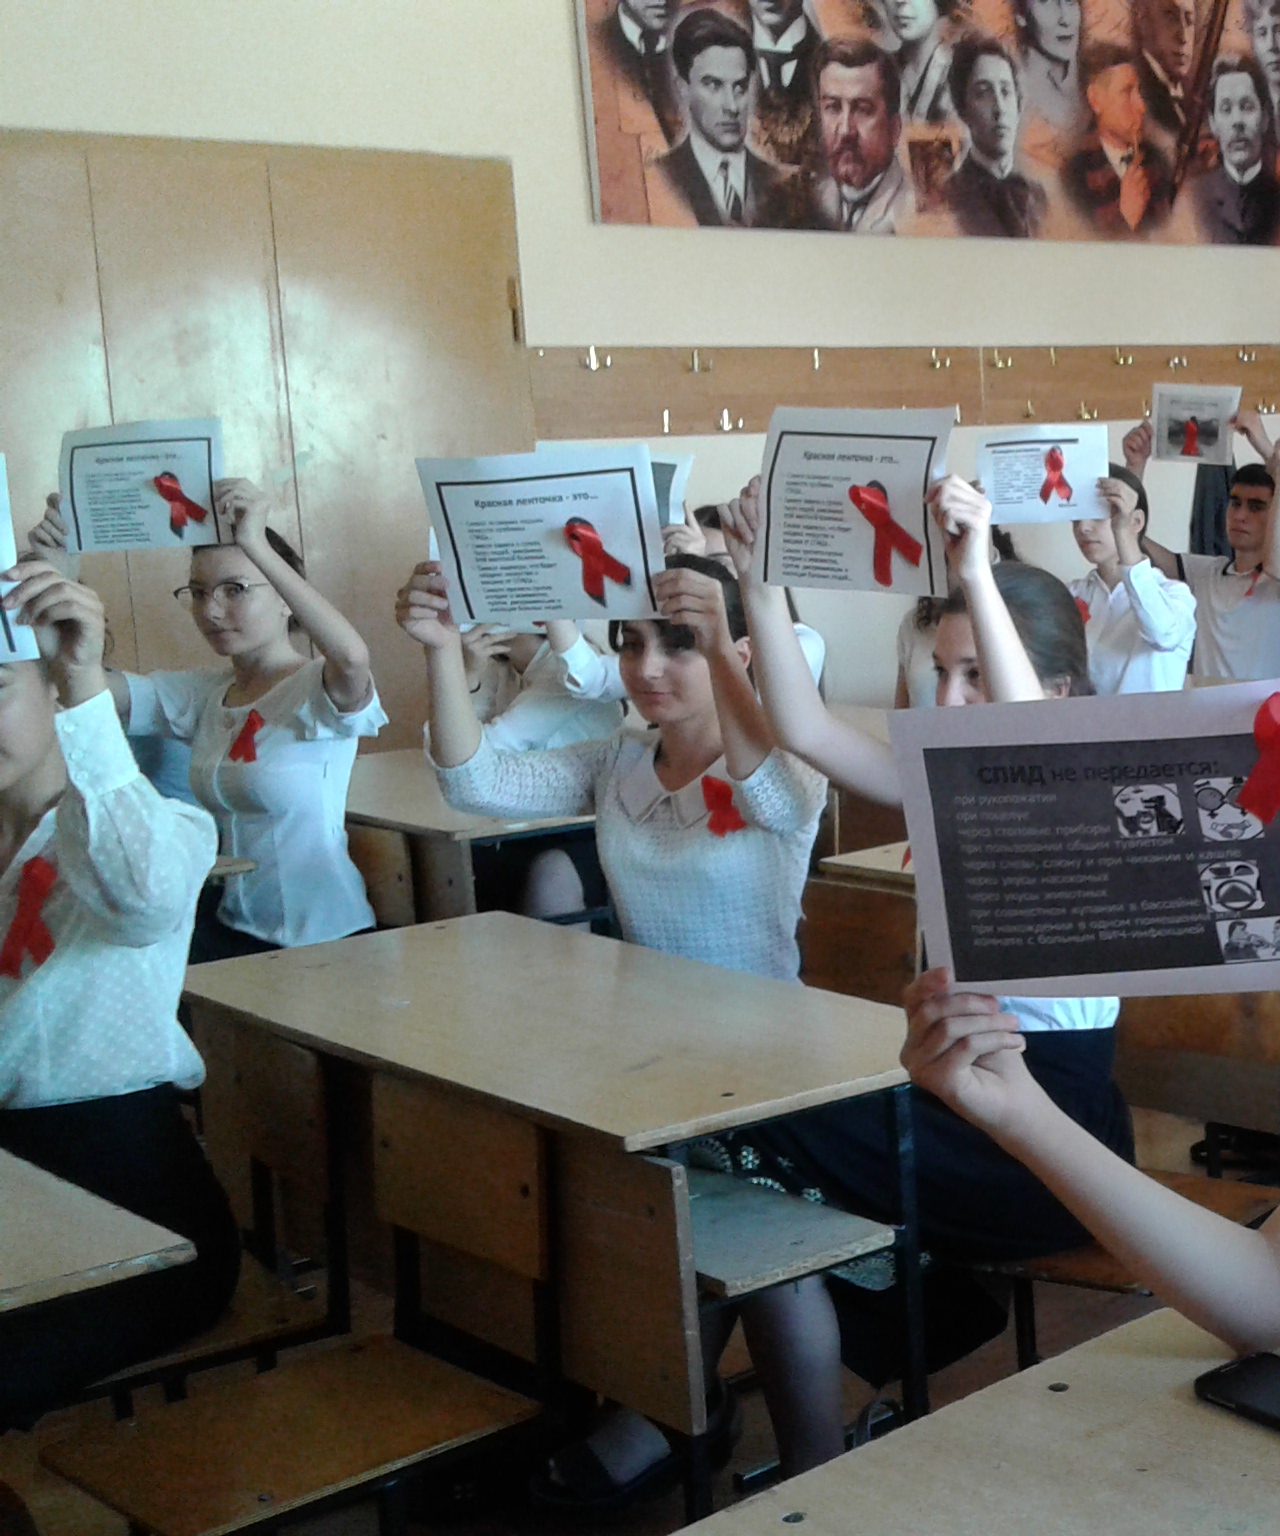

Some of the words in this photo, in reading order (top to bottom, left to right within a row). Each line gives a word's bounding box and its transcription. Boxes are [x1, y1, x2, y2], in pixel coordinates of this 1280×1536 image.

[474, 498, 513, 509] Красная
[516, 494, 564, 506] ленточка
[977, 764, 1047, 786] СПИД
[1050, 766, 1077, 782] не
[1083, 760, 1219, 784] передается:
